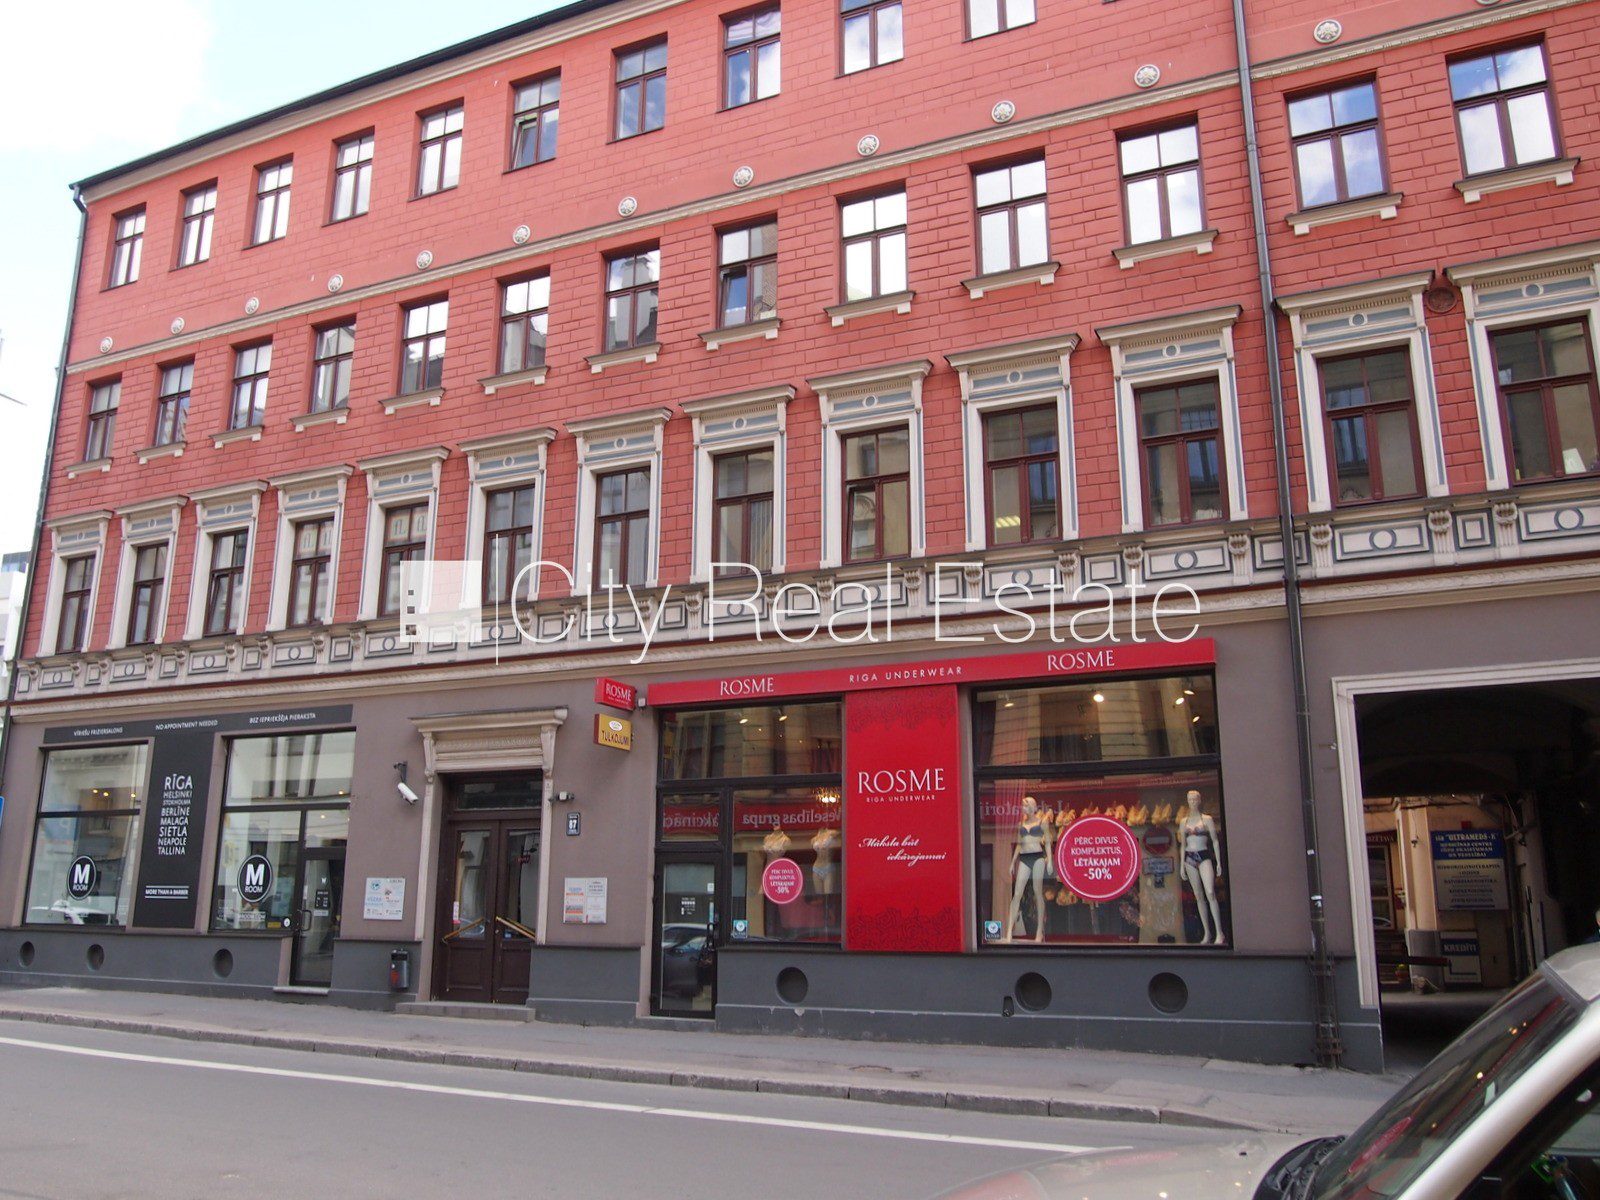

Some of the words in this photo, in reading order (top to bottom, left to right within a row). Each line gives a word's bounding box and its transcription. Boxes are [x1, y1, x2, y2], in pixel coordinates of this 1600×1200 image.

[1047, 650, 1115, 671] ROSME
[849, 674, 878, 683] RIGA
[885, 666, 962, 681] UNDERWEAR
[605, 682, 632, 702] ROSME
[720, 677, 774, 696] ROSME
[164, 721, 198, 730] APPOINTMENT
[198, 719, 218, 727] NEEDED
[164, 773, 193, 790] RĪGA
[858, 768, 946, 794] ROSME
[163, 790, 193, 799] HELSINKI
[888, 794, 936, 802] UNDERWEAR
[161, 806, 190, 816] BERLĪNE
[160, 816, 189, 826] MALAGA
[159, 826, 188, 837] SIETLA
[157, 837, 187, 846] NEAPOLE
[1094, 836, 1119, 844] DIVUS
[157, 846, 186, 855] TALLINA
[73, 864, 91, 884] M
[245, 863, 265, 885] M
[1083, 868, 1112, 880] -50%
[244, 885, 263, 893] ROOM
